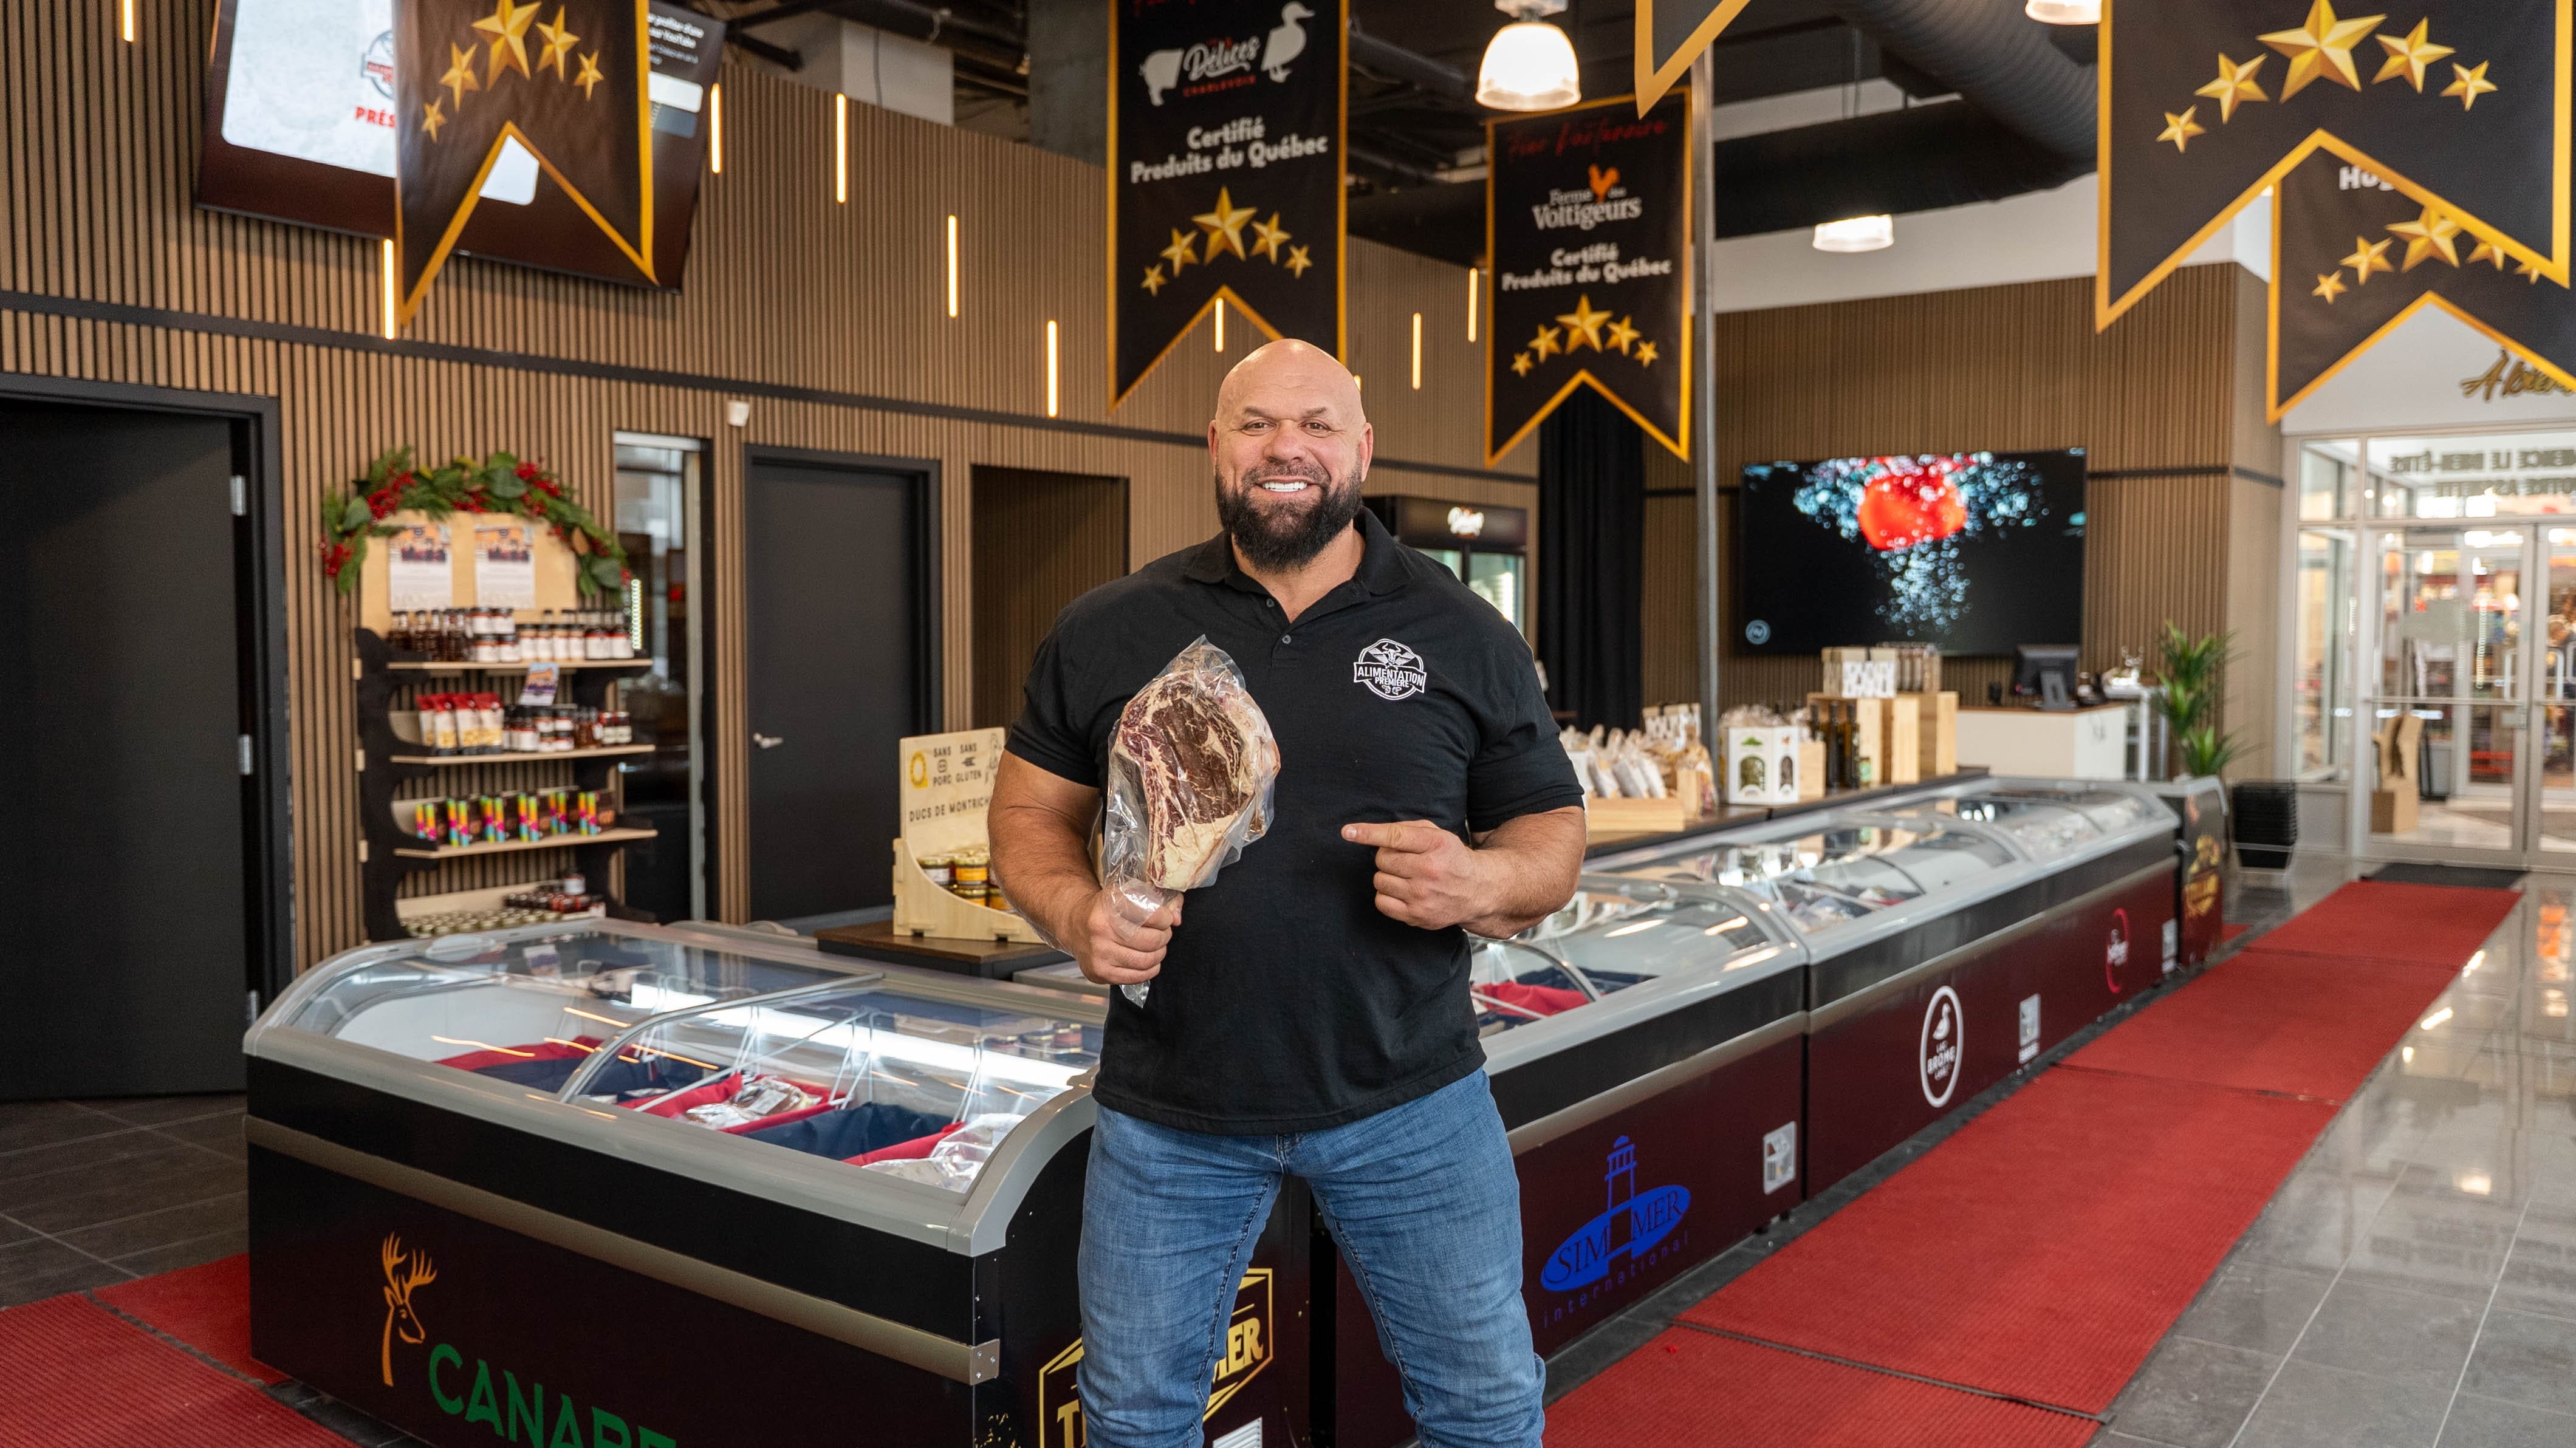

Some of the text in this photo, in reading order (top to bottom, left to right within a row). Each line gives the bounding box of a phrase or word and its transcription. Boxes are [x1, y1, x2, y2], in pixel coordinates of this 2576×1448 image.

[1187, 115, 1265, 149] Certifié
[1131, 132, 1327, 183] Produits du Québec
[1532, 196, 1642, 230] Voltigeurs
[1550, 243, 1619, 267] Certifié
[1501, 256, 1671, 291] Produits du Québec
[1358, 666, 1423, 686] ALIMENTATION
[934, 743, 977, 757] SANS SANS
[933, 770, 981, 786] PORC GLUTEN
[909, 807, 931, 821] DUCS
[935, 805, 945, 816] DE
[1927, 1045, 1956, 1074] BROME
[1544, 1230, 1688, 1328] international
